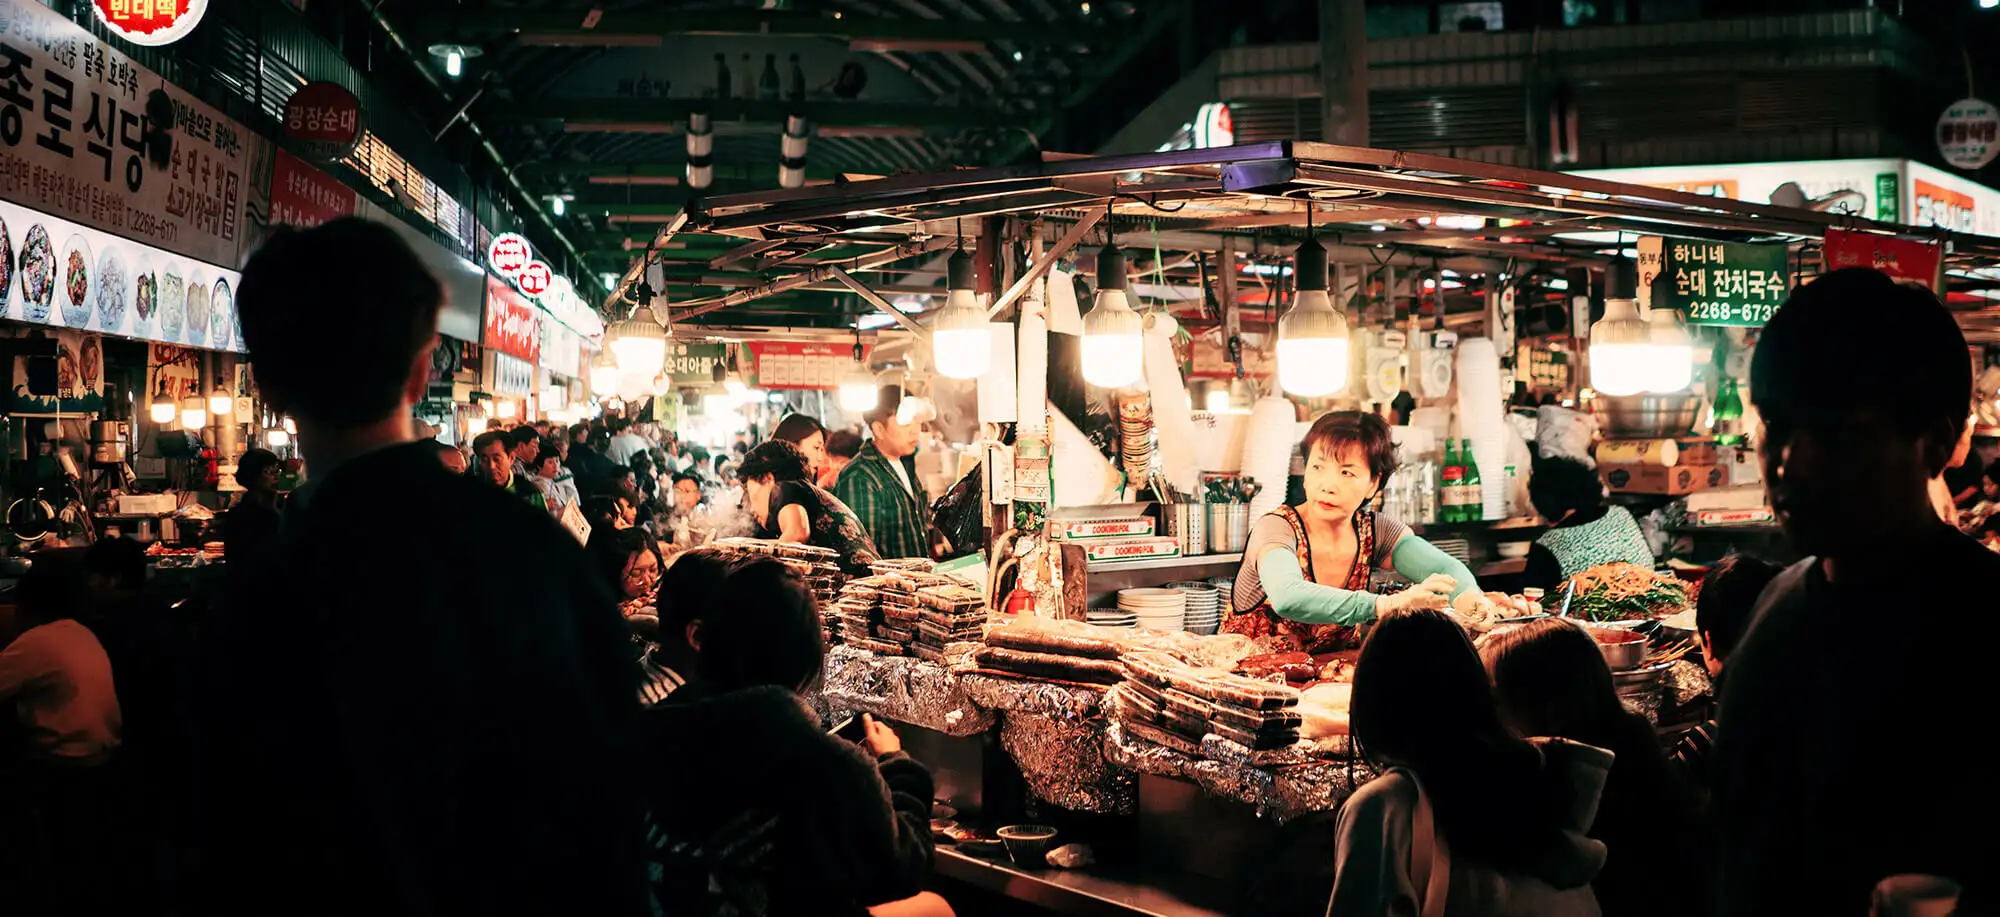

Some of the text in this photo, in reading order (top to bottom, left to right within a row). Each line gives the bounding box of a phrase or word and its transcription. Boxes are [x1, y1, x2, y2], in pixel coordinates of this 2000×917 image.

[110, 0, 176, 21] 빈대떡
[83, 42, 105, 84] 팥죽
[107, 56, 139, 101] 호박죽
[0, 42, 149, 193] 종로식당
[171, 98, 212, 143] 가마솥으로
[288, 104, 357, 134] 광장순대
[1673, 244, 1725, 265] 하니네
[1675, 266, 1786, 302] 순대 잔치국수
[1092, 524, 1119, 535] COOKING
[1114, 545, 1143, 556] COOKING
